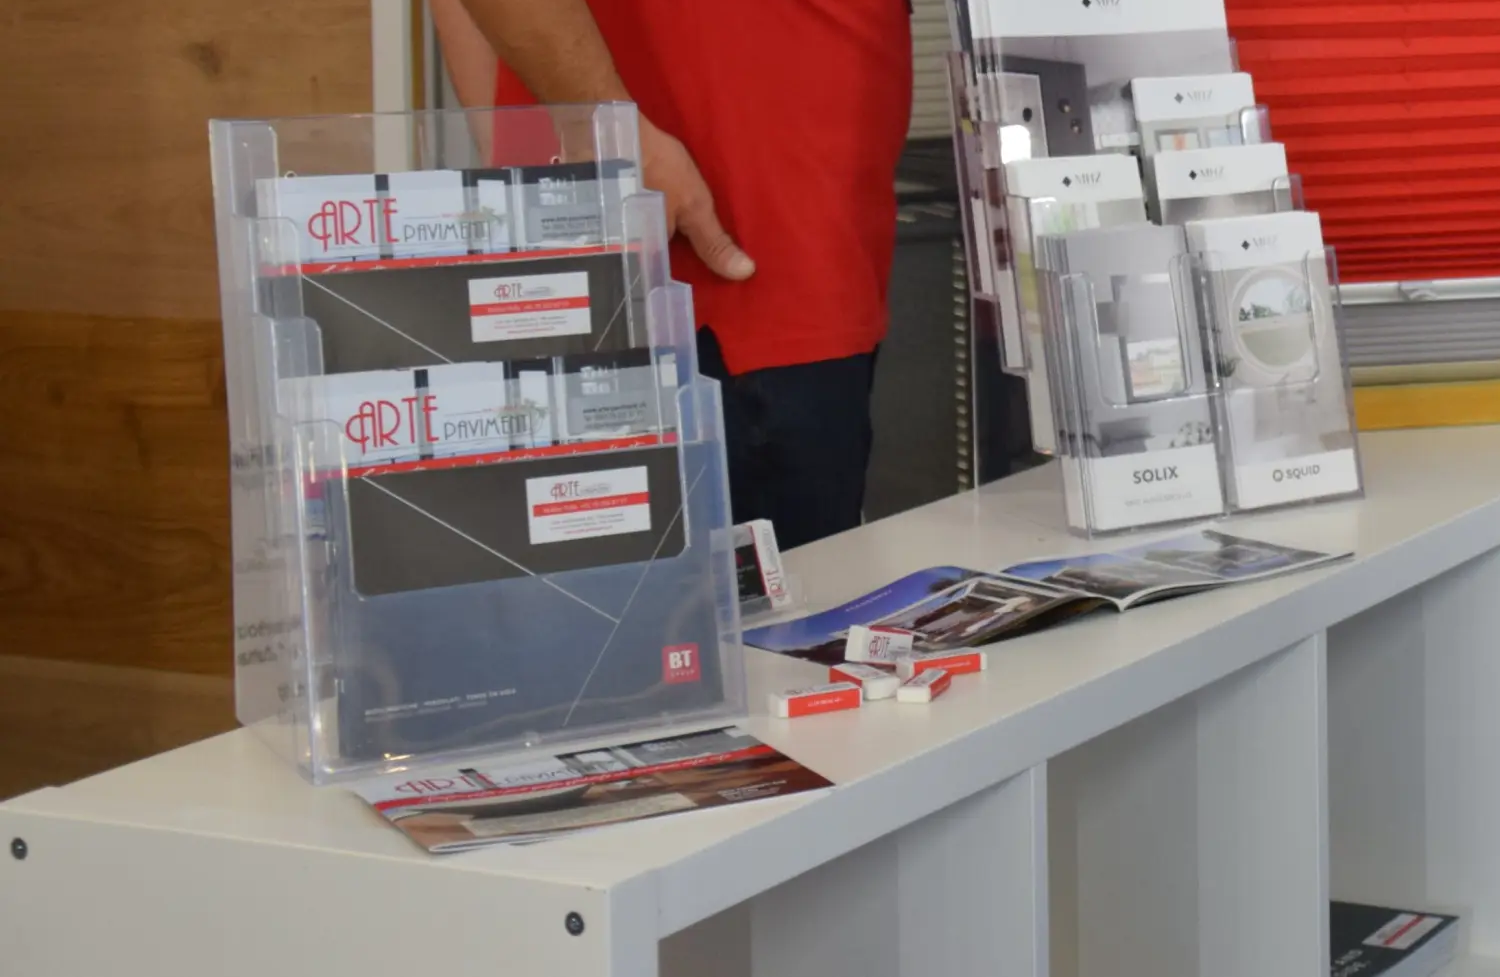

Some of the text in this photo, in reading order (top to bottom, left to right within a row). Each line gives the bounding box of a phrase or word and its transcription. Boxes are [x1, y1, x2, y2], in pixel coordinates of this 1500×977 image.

[308, 198, 400, 252] ARTE
[345, 395, 440, 455] ARTE
[1133, 466, 1178, 484] SOLIX
[1286, 464, 1320, 480] SQUID
[669, 650, 692, 669] BT
